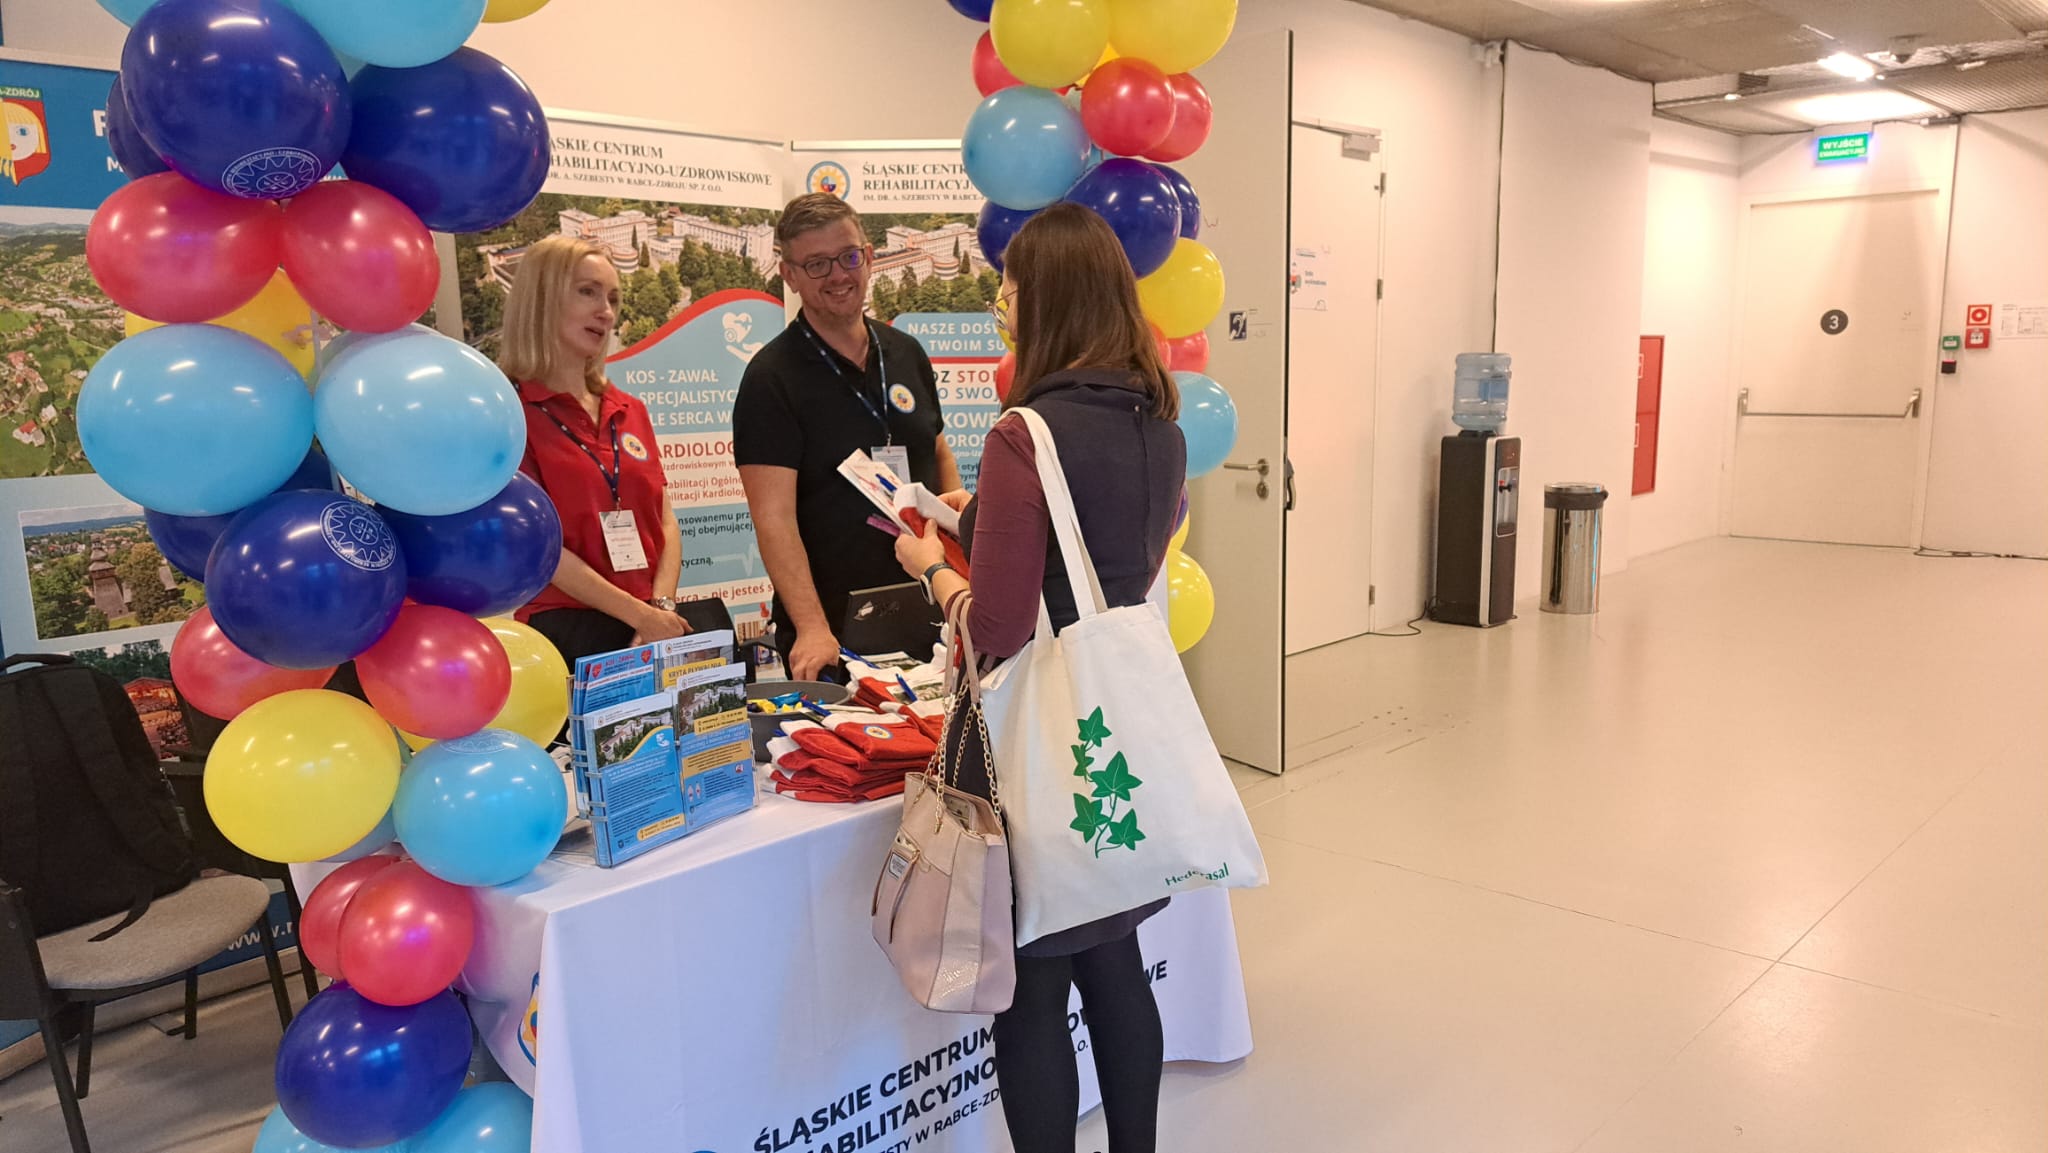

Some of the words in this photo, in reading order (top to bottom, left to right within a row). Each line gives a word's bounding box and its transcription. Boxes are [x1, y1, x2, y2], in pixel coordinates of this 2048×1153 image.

[593, 140, 663, 159] CENTRUM
[862, 161, 920, 177] ŚLĄSKIE
[863, 179, 974, 191] REHABILITACYJ
[908, 323, 956, 335] NASZE
[1829, 315, 1839, 330] 3
[928, 340, 982, 351] TWOIM
[626, 370, 656, 384] KOS
[668, 369, 719, 383] ZAWAŁ
[957, 370, 997, 383] STO
[670, 412, 714, 425] SERCA
[717, 411, 731, 424] W
[658, 441, 734, 458] RDIOLO
[698, 522, 753, 535] obejmującej
[754, 1084, 872, 1153] ŚLĄSKIE
[880, 1021, 996, 1097] CENTRUM
[808, 1057, 997, 1153] ABILITACYJNO
[915, 1125, 931, 1143] W
